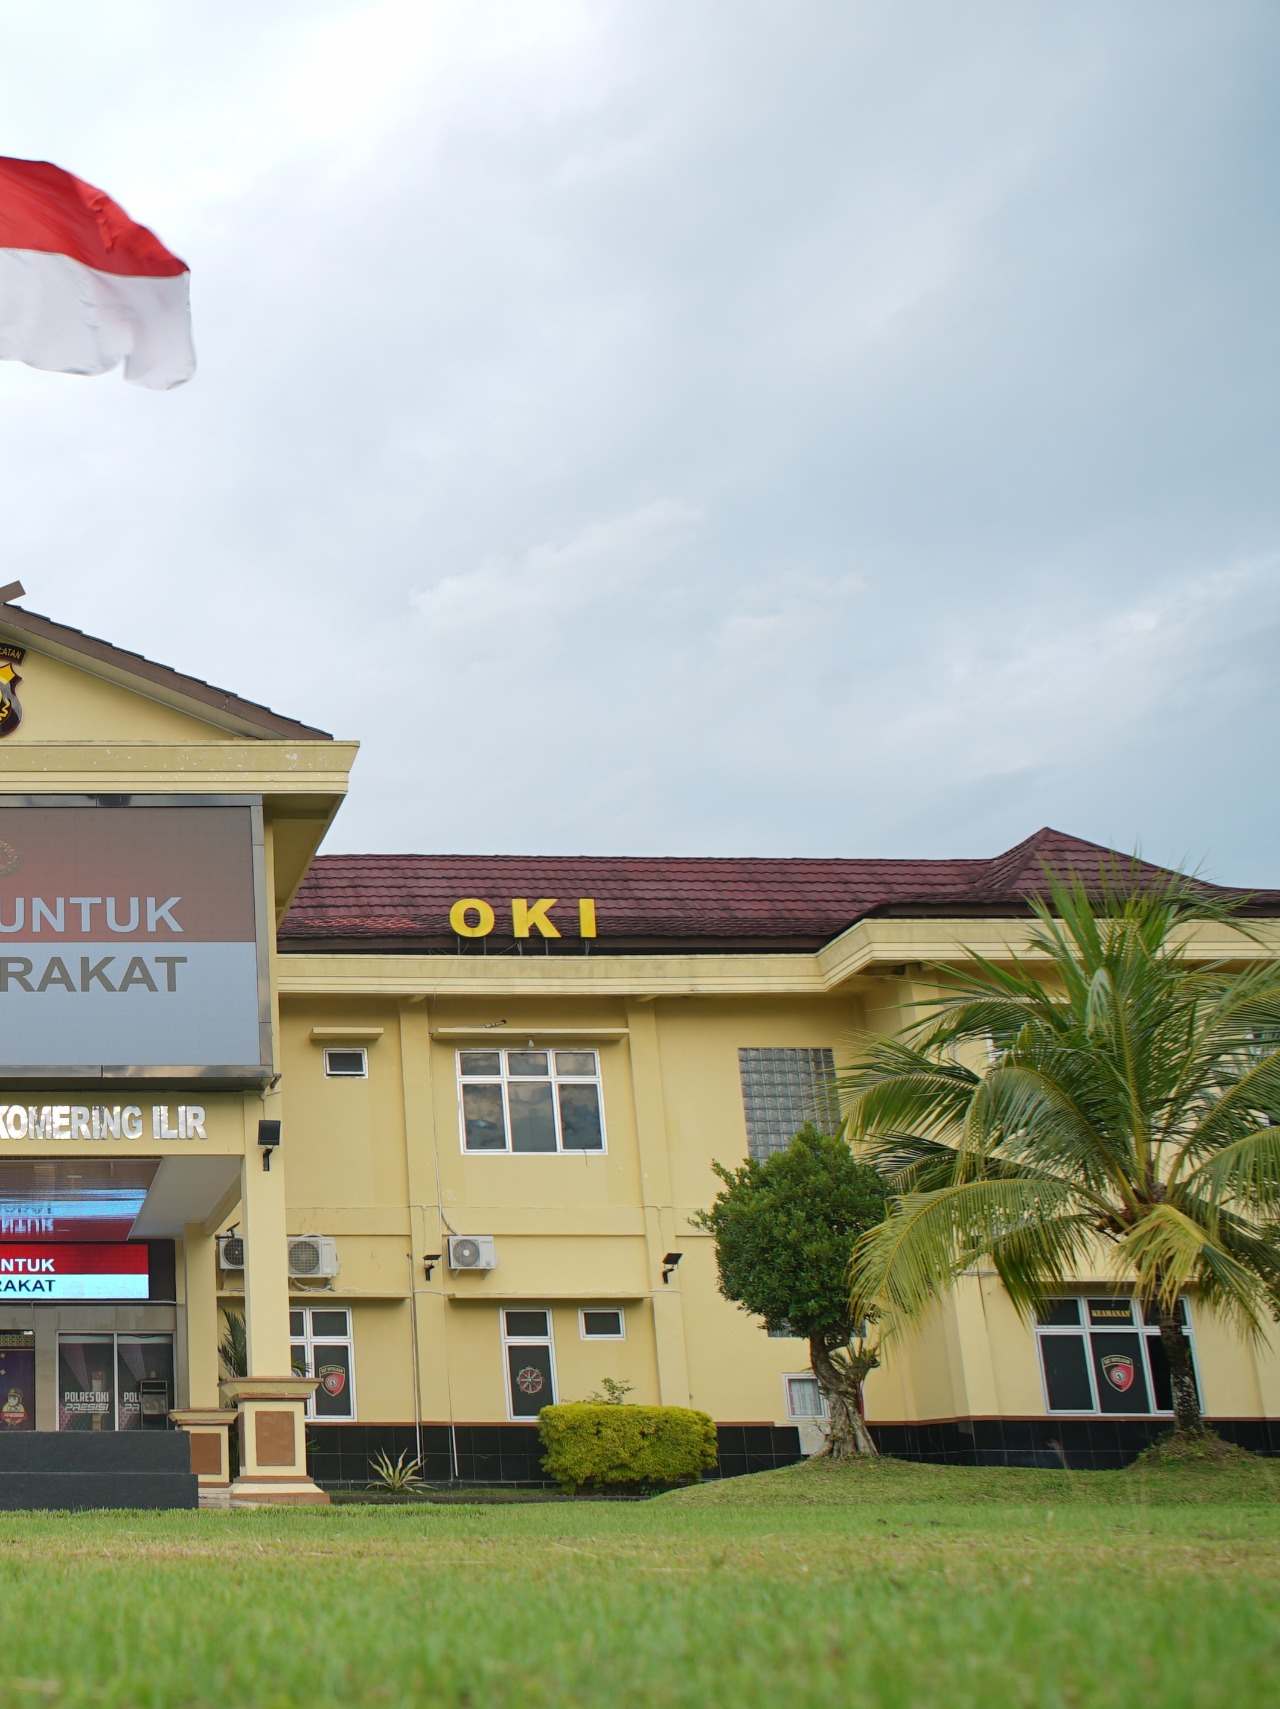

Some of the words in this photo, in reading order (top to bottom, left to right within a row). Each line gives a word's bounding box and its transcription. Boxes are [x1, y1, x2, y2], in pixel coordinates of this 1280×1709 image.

[449, 898, 597, 938] OKI
[152, 1105, 208, 1140] ILIR
[64, 1391, 94, 1402] POLRES
[95, 1391, 109, 1402] OKI
[64, 1403, 109, 1411] PRESISI
